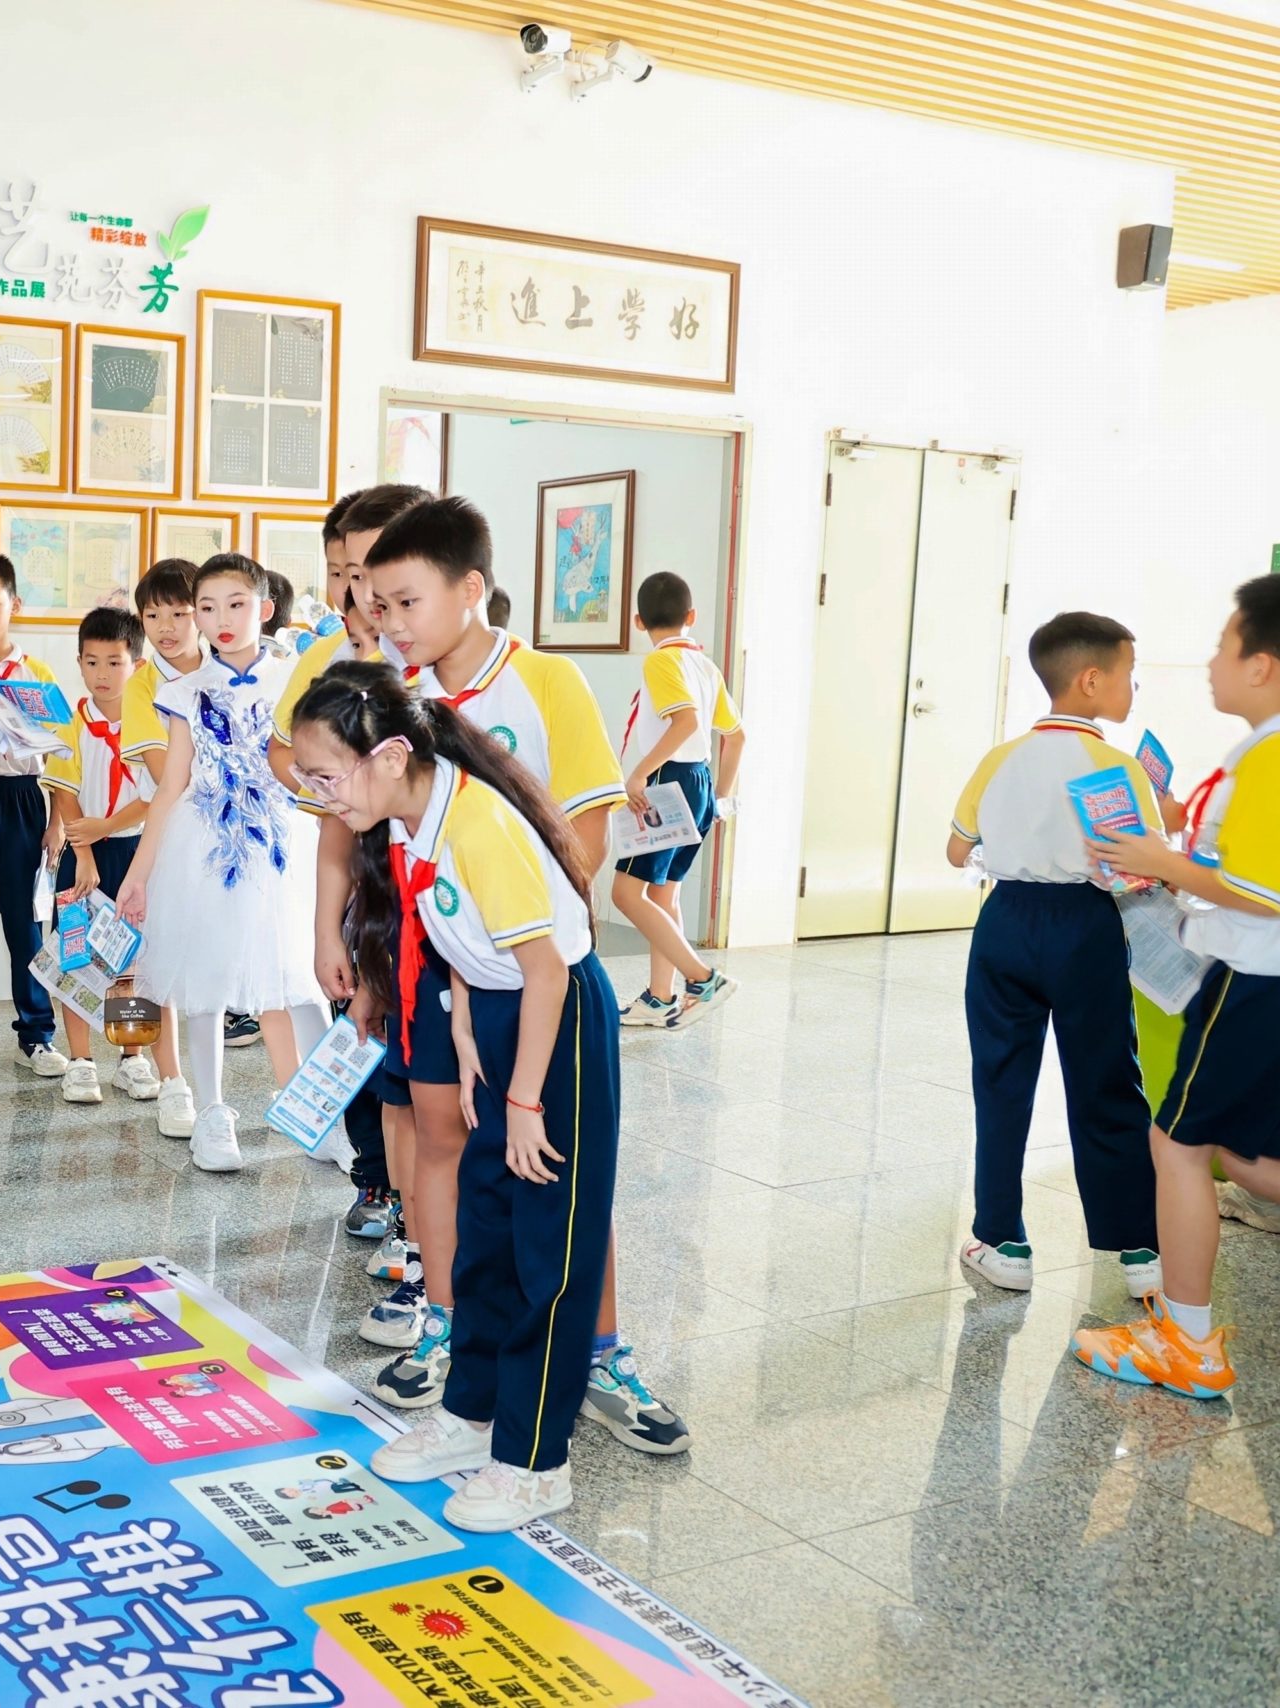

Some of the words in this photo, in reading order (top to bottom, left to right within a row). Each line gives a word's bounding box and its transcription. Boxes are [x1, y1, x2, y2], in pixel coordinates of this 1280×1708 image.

[90, 227, 147, 247] 精彩绽放
[201, 1364, 226, 1373] 3
[319, 1456, 346, 1469] 2
[319, 1532, 358, 1556] 手段
[473, 1579, 496, 1591] 1
[415, 1645, 499, 1708] 病或虚弱
